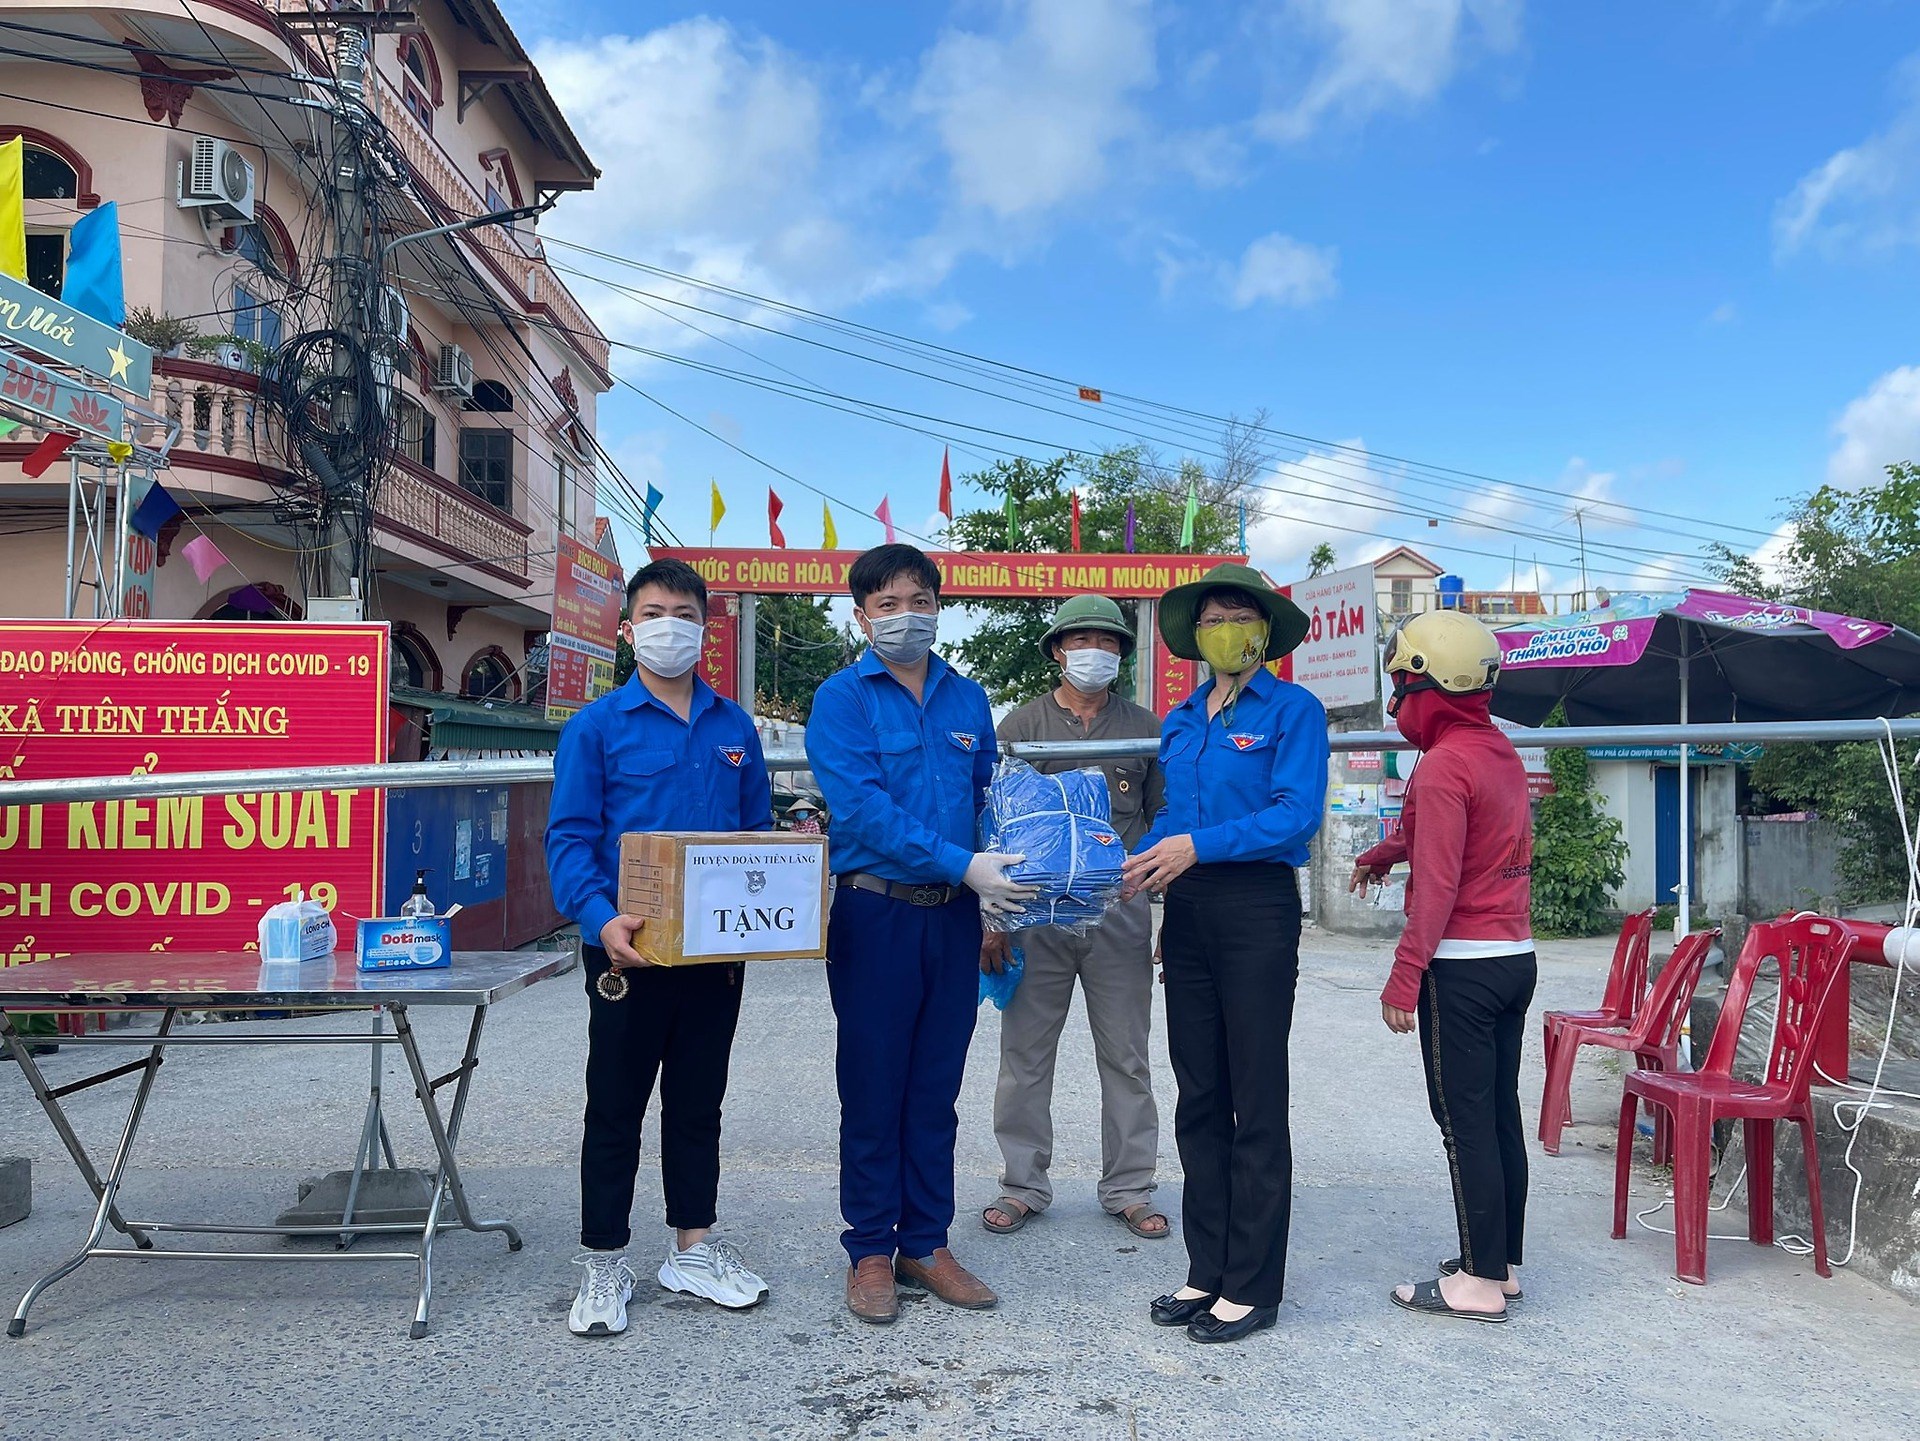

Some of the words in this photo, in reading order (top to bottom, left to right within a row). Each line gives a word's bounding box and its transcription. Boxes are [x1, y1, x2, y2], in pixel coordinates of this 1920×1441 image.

[2, 359, 57, 411] 2021
[736, 557, 789, 587] CỘNG
[795, 558, 834, 584] HÒA
[952, 562, 1011, 587] NGHĨA
[1016, 562, 1057, 592] VIỆT
[1062, 567, 1106, 588] NAM
[1112, 563, 1169, 589] MUÔN
[1175, 563, 1211, 587] NĂ
[1303, 605, 1322, 644] Ô
[1326, 600, 1364, 640] TÁM
[1560, 627, 1598, 643] LƯNG
[1578, 636, 1610, 653] HÔI
[0, 650, 45, 679] ĐẠO
[50, 645, 127, 677] PHÒNG,
[133, 642, 206, 675] CHỐNG
[212, 655, 260, 681] DỊCH
[266, 655, 329, 676] COVID
[347, 655, 370, 676] 19
[0, 697, 44, 733] XÃ
[56, 696, 147, 734] TIÊN
[157, 690, 290, 735] THẮNG
[693, 855, 729, 867] HUYỆN
[763, 853, 786, 864] TIÊN
[789, 853, 815, 864] LÃNG
[69, 881, 231, 918] COVID
[283, 881, 338, 914] 19
[305, 923, 320, 935] LONG
[712, 904, 795, 938] TẶNG
